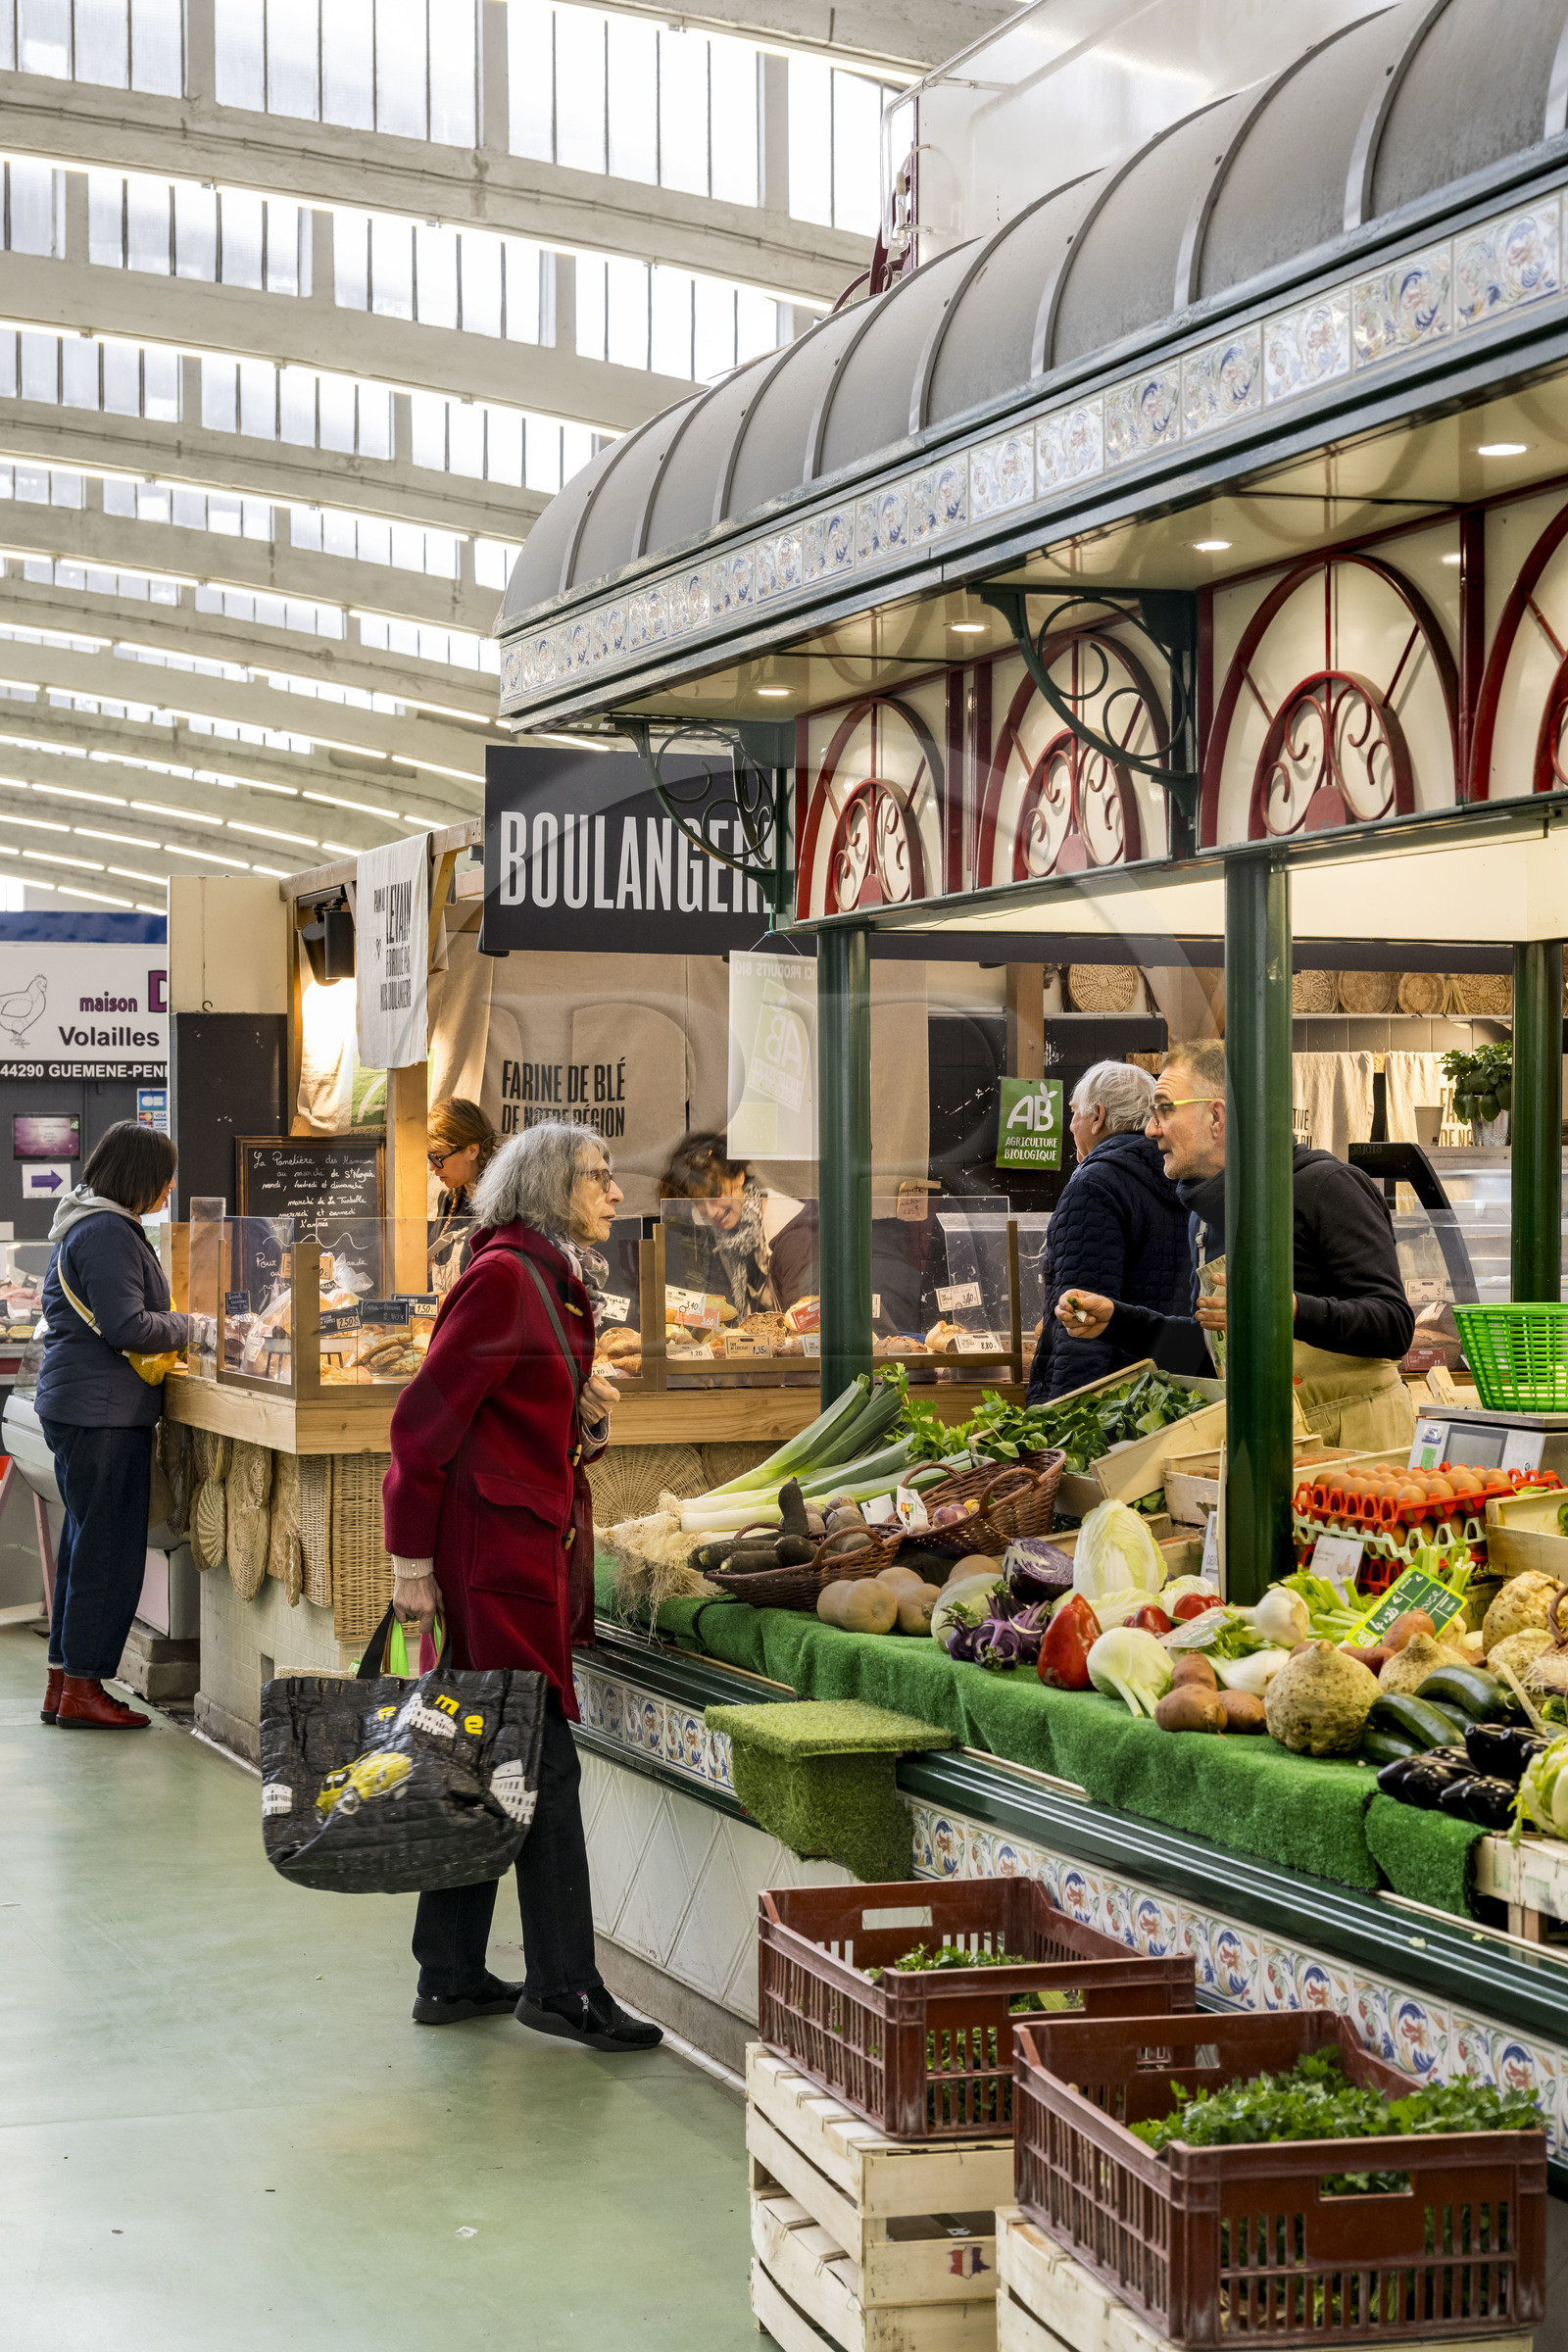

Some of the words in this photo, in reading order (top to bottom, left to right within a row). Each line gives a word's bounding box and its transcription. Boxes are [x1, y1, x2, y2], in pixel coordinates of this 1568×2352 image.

[79, 991, 137, 1011] maison
[59, 1026, 160, 1046] Volailles
[0, 1063, 44, 1077] 44290
[502, 1059, 563, 1102] FARINE
[567, 1064, 589, 1102] DE
[594, 1056, 626, 1102] BLÉ
[502, 1103, 520, 1135] DE
[1006, 1095, 1054, 1131] AB
[1005, 1137, 1058, 1149] AGRICULTURE
[254, 1152, 266, 1168] La
[325, 1154, 337, 1164] des
[1004, 1148, 1057, 1162] BIOLOGIQUE
[331, 1168, 339, 1177] de
[318, 1197, 325, 1205] de
